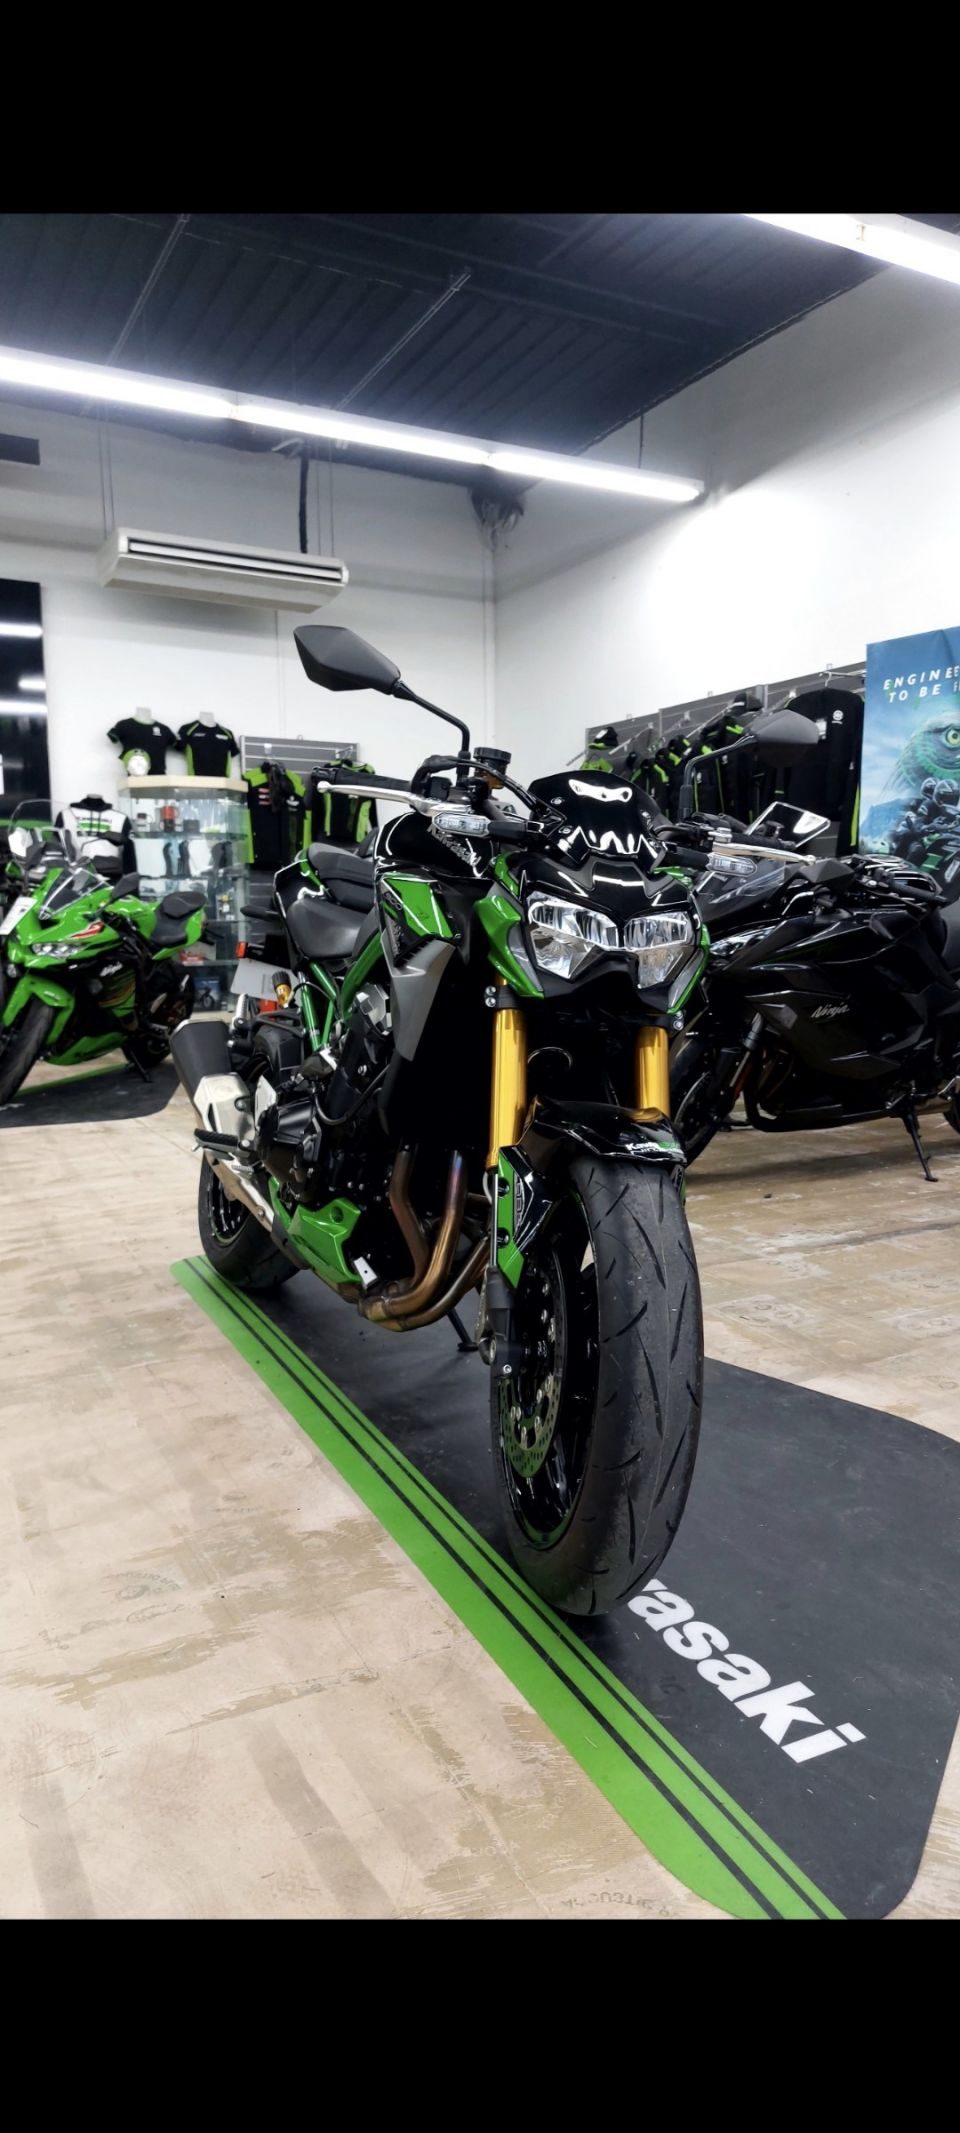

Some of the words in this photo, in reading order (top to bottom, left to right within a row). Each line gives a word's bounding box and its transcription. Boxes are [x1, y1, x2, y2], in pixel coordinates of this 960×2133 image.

[888, 689, 909, 703] TO
[919, 683, 942, 698] BE
[810, 1001, 850, 1020] Ninja
